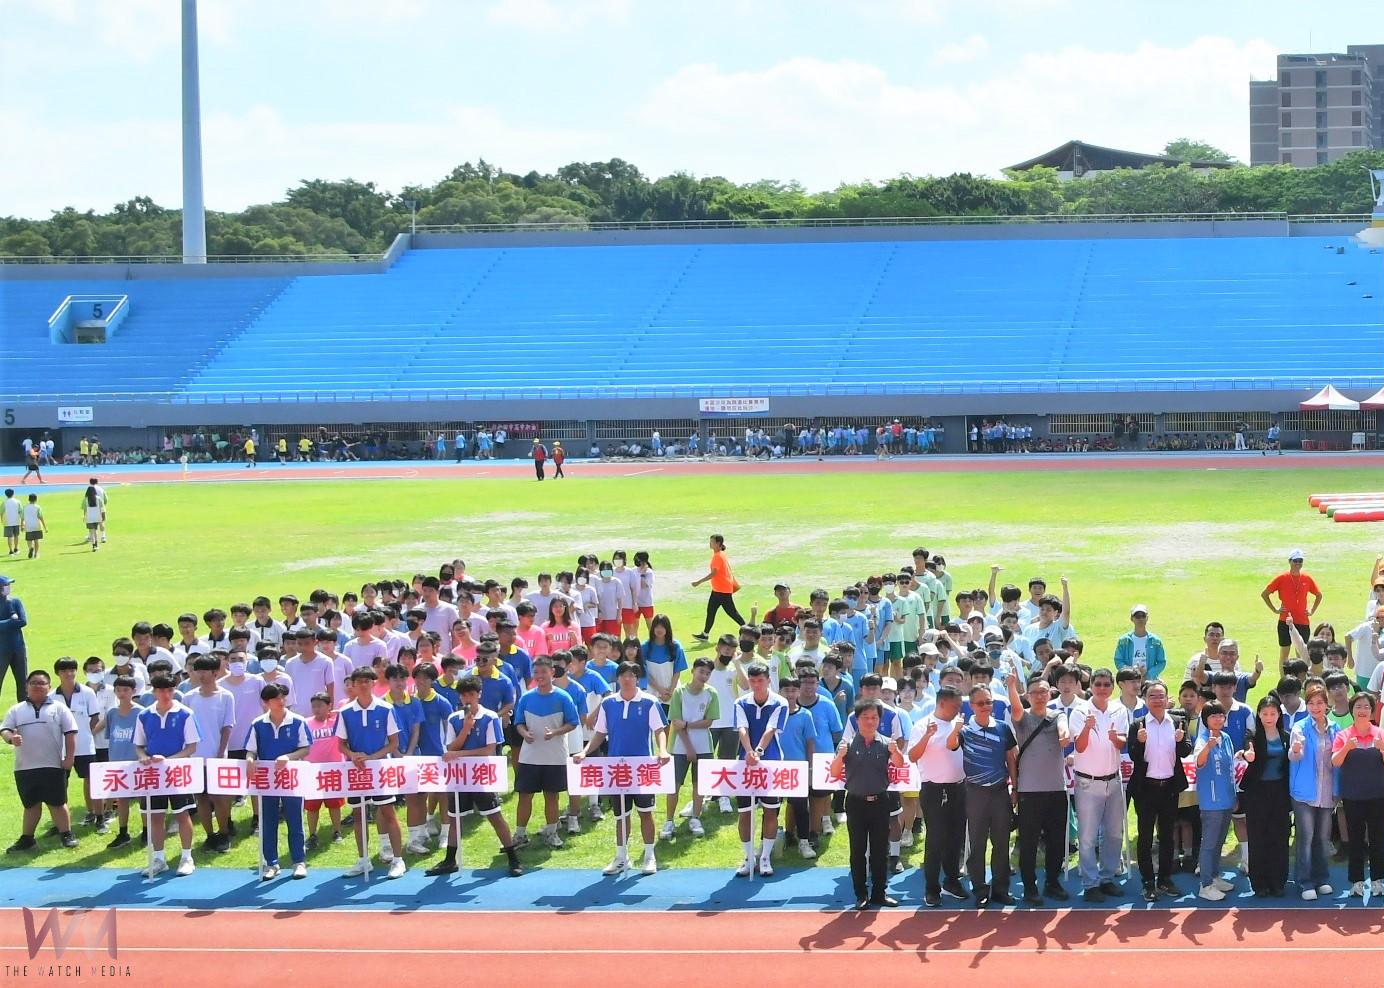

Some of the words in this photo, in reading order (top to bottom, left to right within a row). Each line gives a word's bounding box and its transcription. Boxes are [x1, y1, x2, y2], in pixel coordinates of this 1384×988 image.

[93, 303, 103, 319] 5
[4, 408, 16, 425] 5
[103, 764, 193, 792] 永靖鄉
[217, 766, 299, 791] 田尾鄉
[315, 765, 406, 792] 埔鹽鄉
[417, 762, 498, 786] 溪州鄉
[711, 767, 799, 790] 大城鄉
